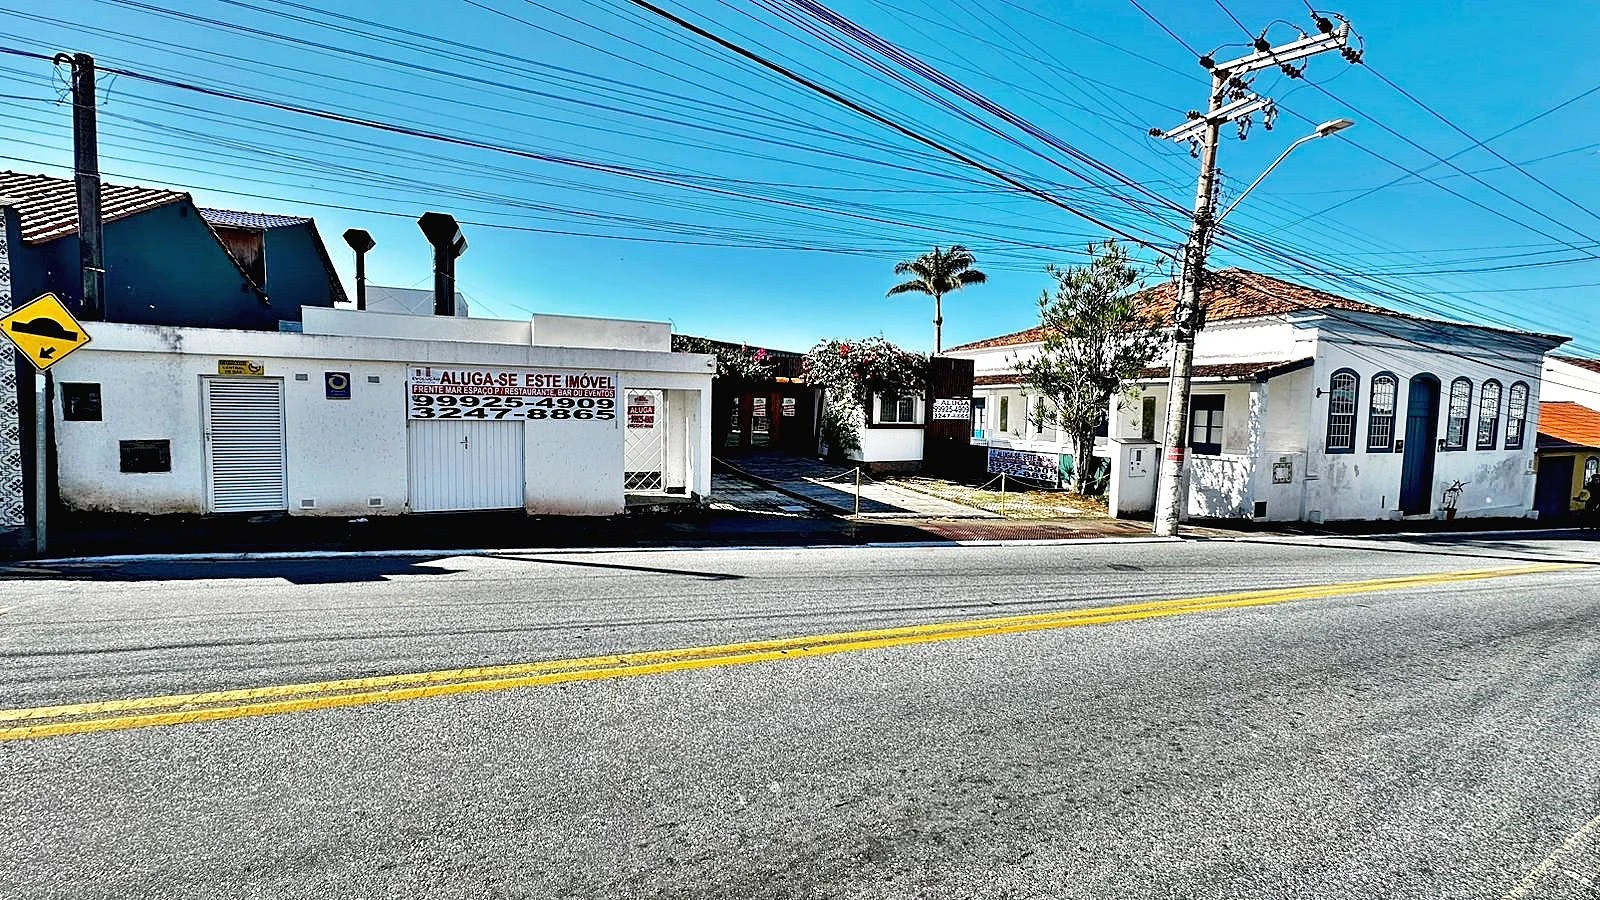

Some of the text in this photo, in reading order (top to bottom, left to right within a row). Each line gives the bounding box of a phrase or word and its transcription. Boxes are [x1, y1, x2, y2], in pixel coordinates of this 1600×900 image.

[440, 371, 614, 389] ALUGA-SE ESTE IMÓVEL
[413, 385, 444, 394] FRENTE
[445, 386, 462, 394] MAR
[464, 387, 493, 395] ESPAÇO
[412, 395, 615, 409] 99925-4909
[412, 407, 615, 420] 3247-8865
[630, 406, 653, 414] ALUGA
